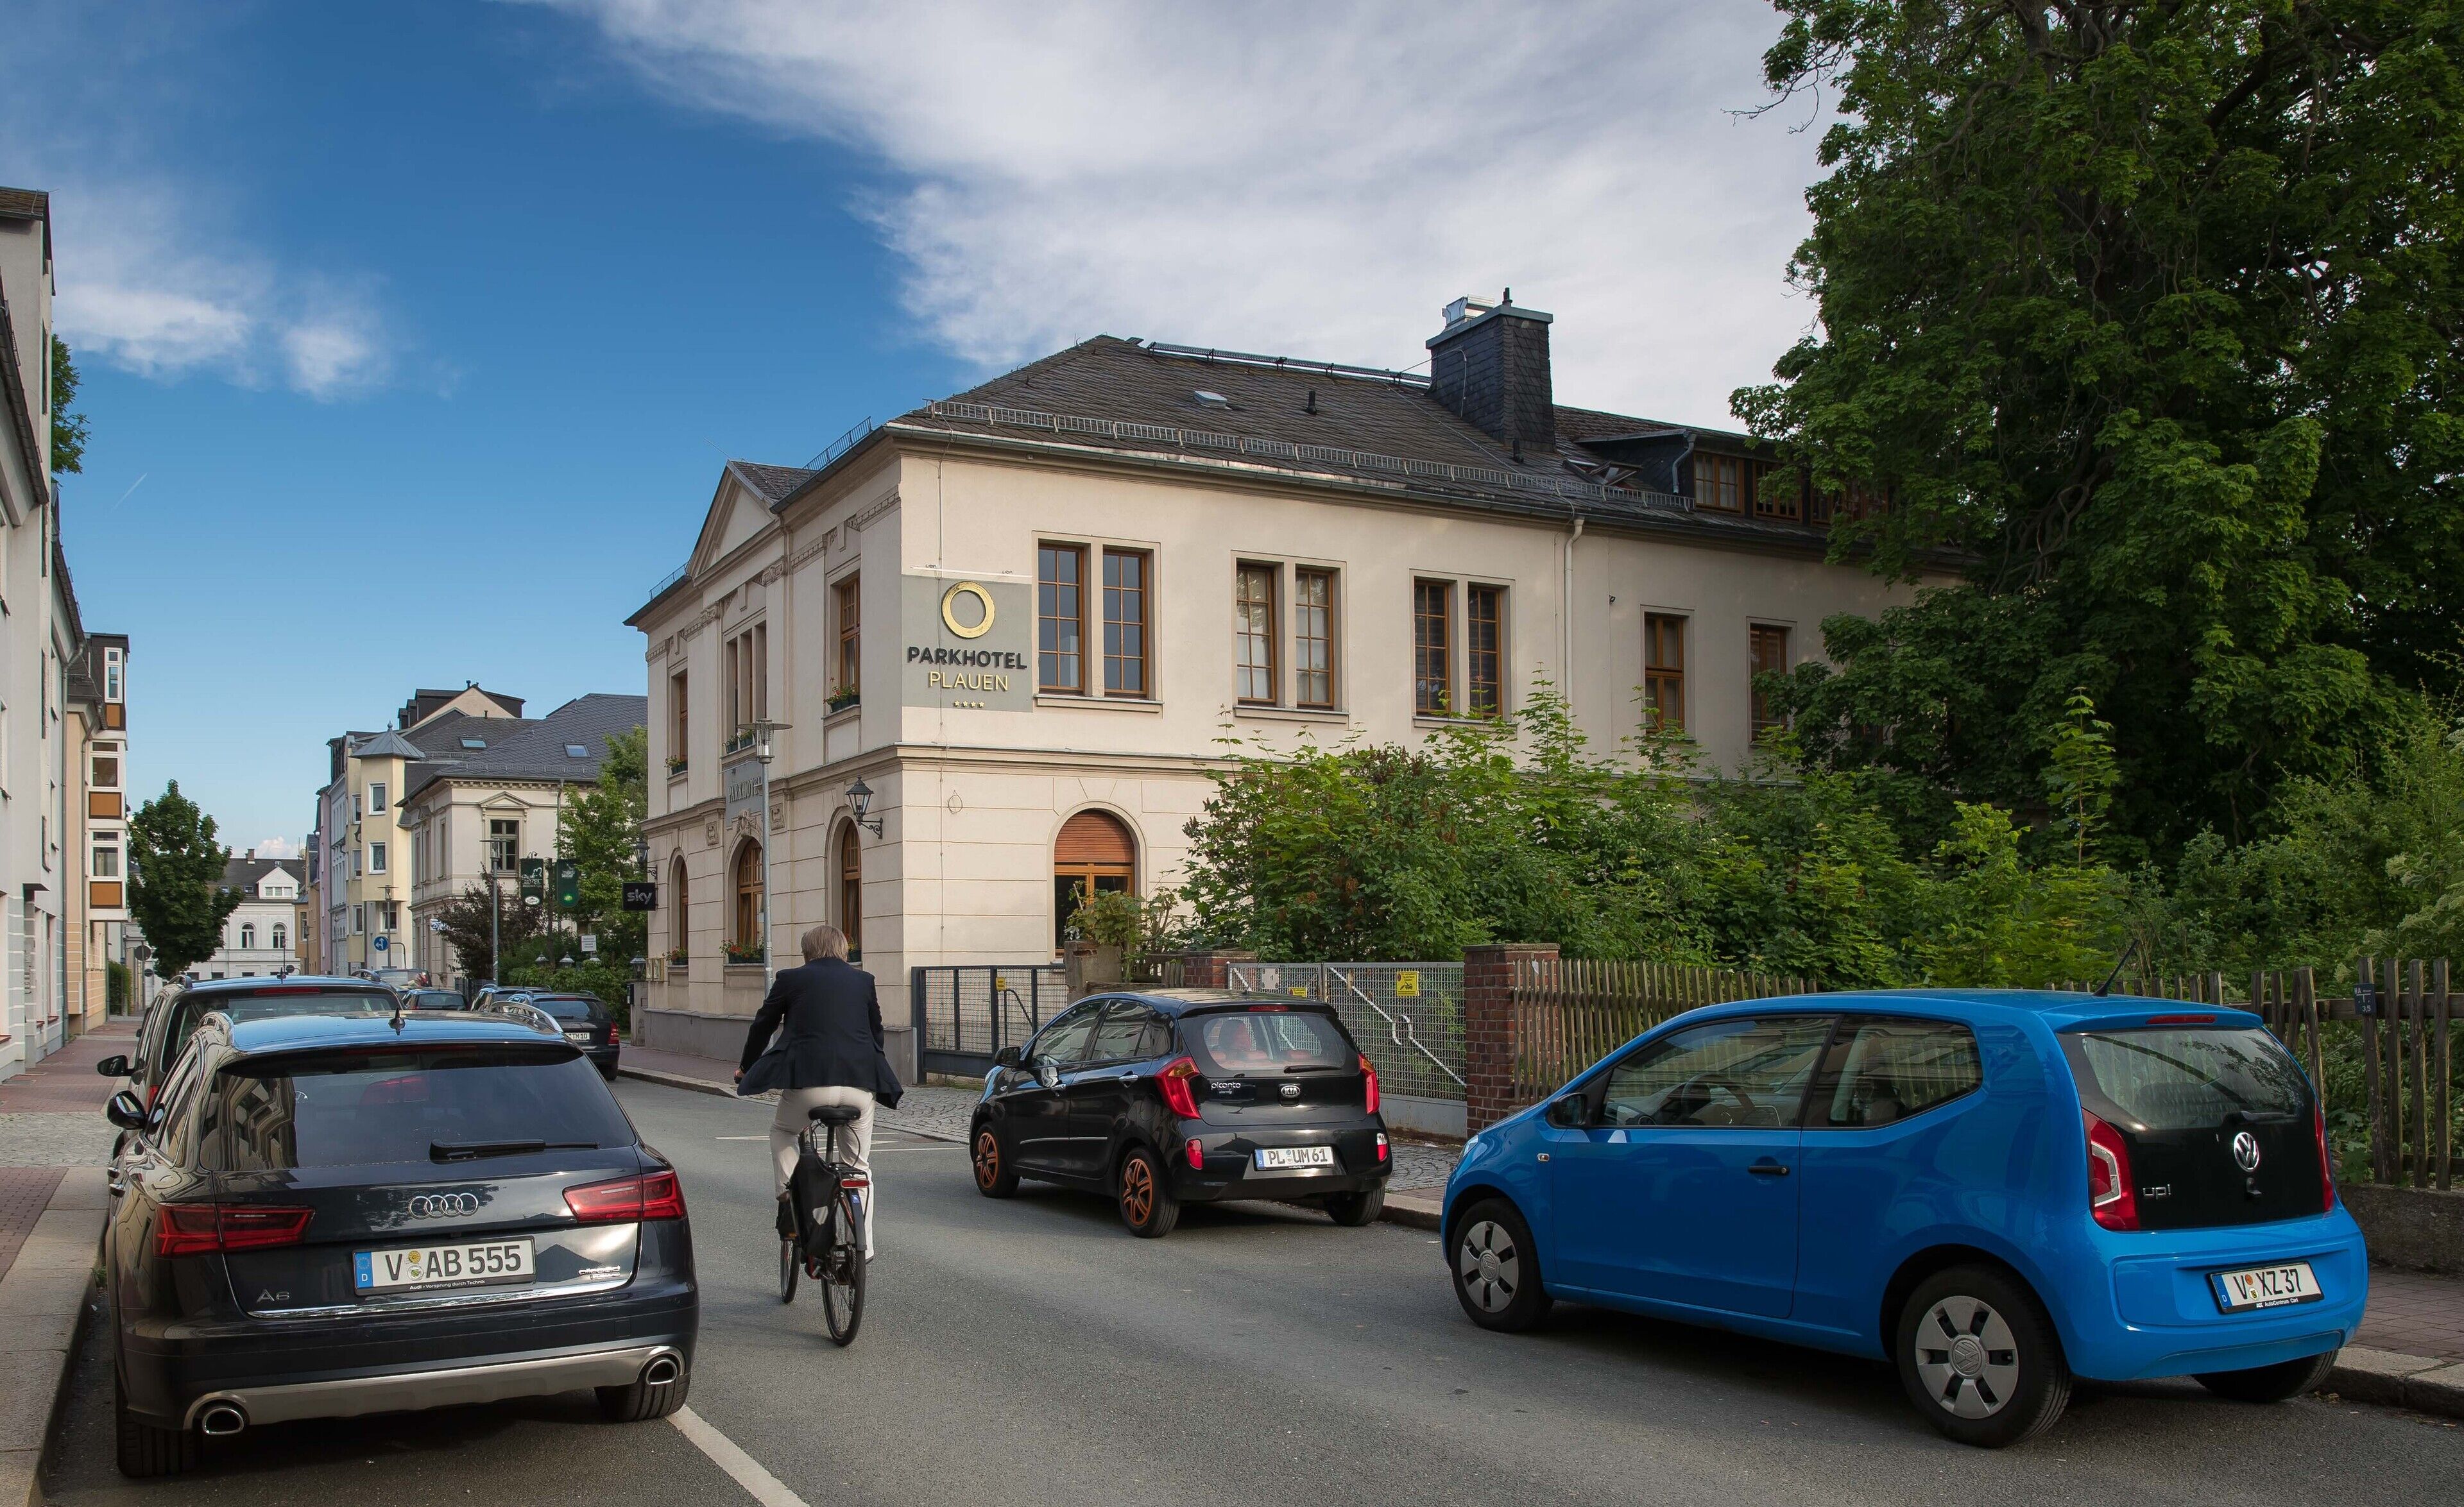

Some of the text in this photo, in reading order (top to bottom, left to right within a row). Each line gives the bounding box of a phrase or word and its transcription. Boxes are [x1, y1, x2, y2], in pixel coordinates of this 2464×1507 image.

[907, 646, 1027, 669] PARKHOTEL
[929, 671, 1008, 691] PLAUEN
[627, 889, 653, 905] sky
[1211, 1082, 1241, 1091] picanto
[1283, 1086, 1298, 1095] KIA
[1267, 1148, 1328, 1164] PL UM 61
[385, 1245, 522, 1281] V AB 555
[2233, 1268, 2302, 1300] V XZ 37
[257, 1289, 289, 1302] A6
